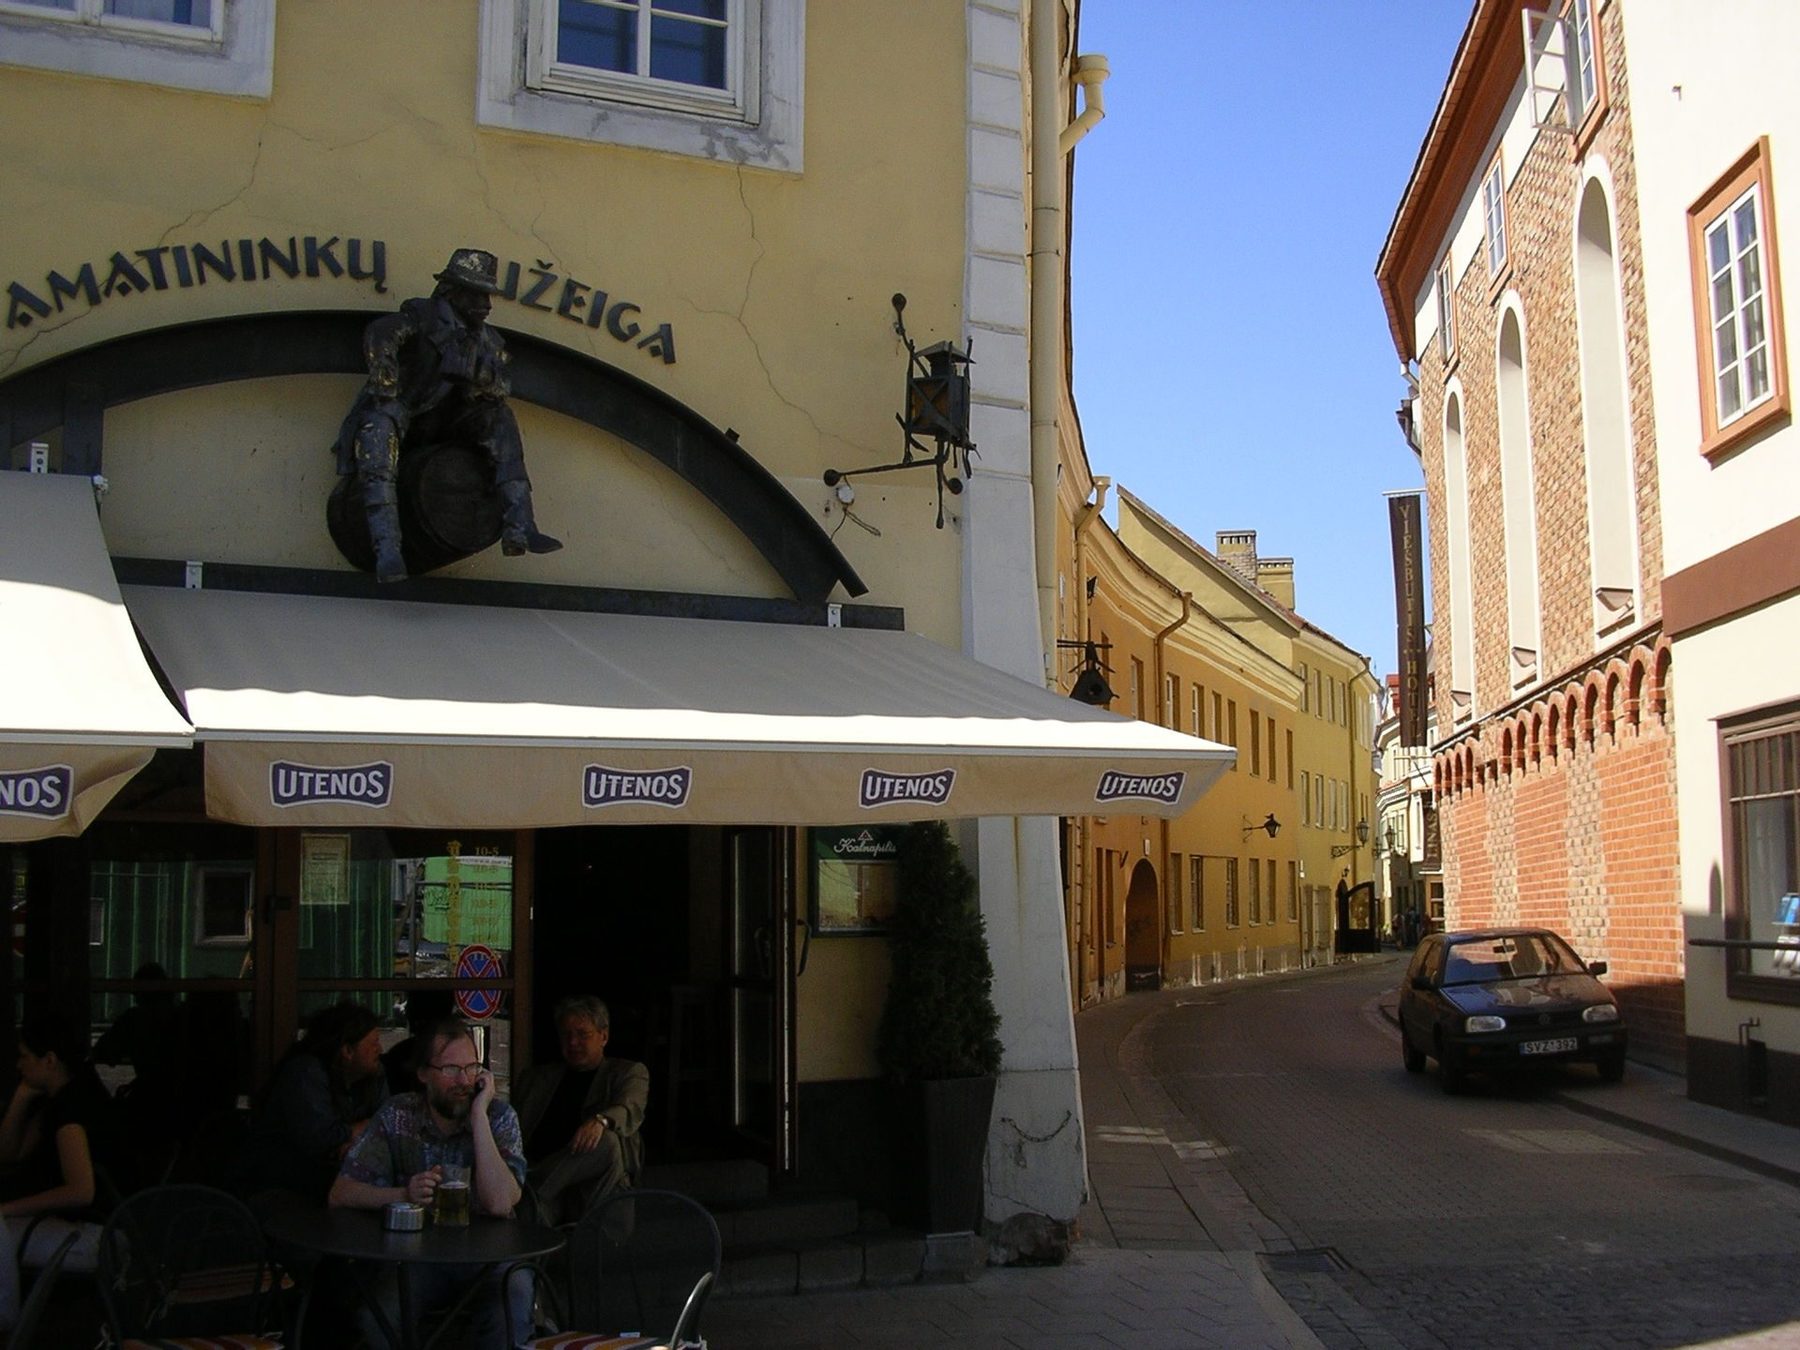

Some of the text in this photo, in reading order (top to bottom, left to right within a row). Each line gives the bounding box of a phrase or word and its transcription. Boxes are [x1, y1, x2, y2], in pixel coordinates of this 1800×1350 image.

[6, 236, 388, 330] AMATININKŲ
[277, 768, 385, 798] UTENOS
[588, 771, 683, 801] UTENOS
[864, 774, 948, 801] UTENOS
[1101, 775, 1178, 798] UTENOS
[1526, 1041, 1549, 1054] SVZ
